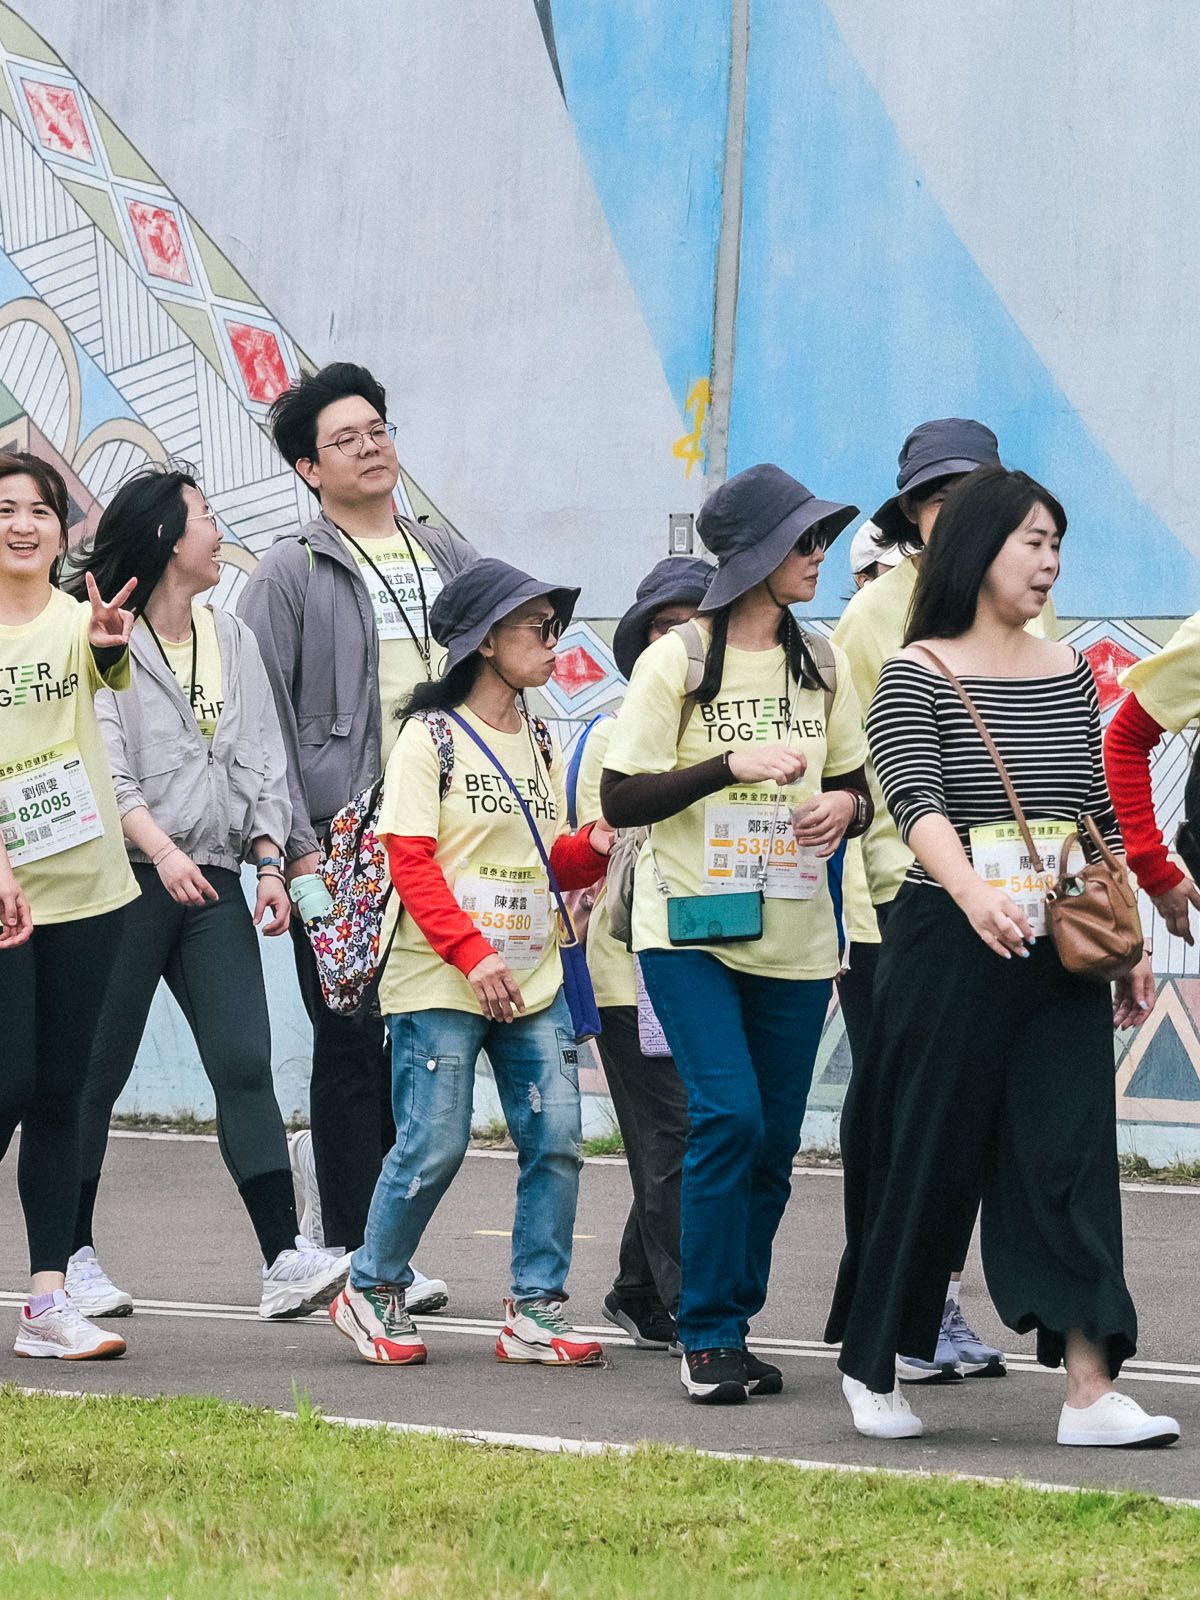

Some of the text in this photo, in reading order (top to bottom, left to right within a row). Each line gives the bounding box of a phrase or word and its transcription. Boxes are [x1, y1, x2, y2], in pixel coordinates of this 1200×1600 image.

[700, 697, 790, 722] BETTER
[704, 719, 825, 742] TOGETHER
[18, 791, 71, 823] 82095
[1019, 854, 1056, 870] 周君
[481, 912, 531, 930] 53580
